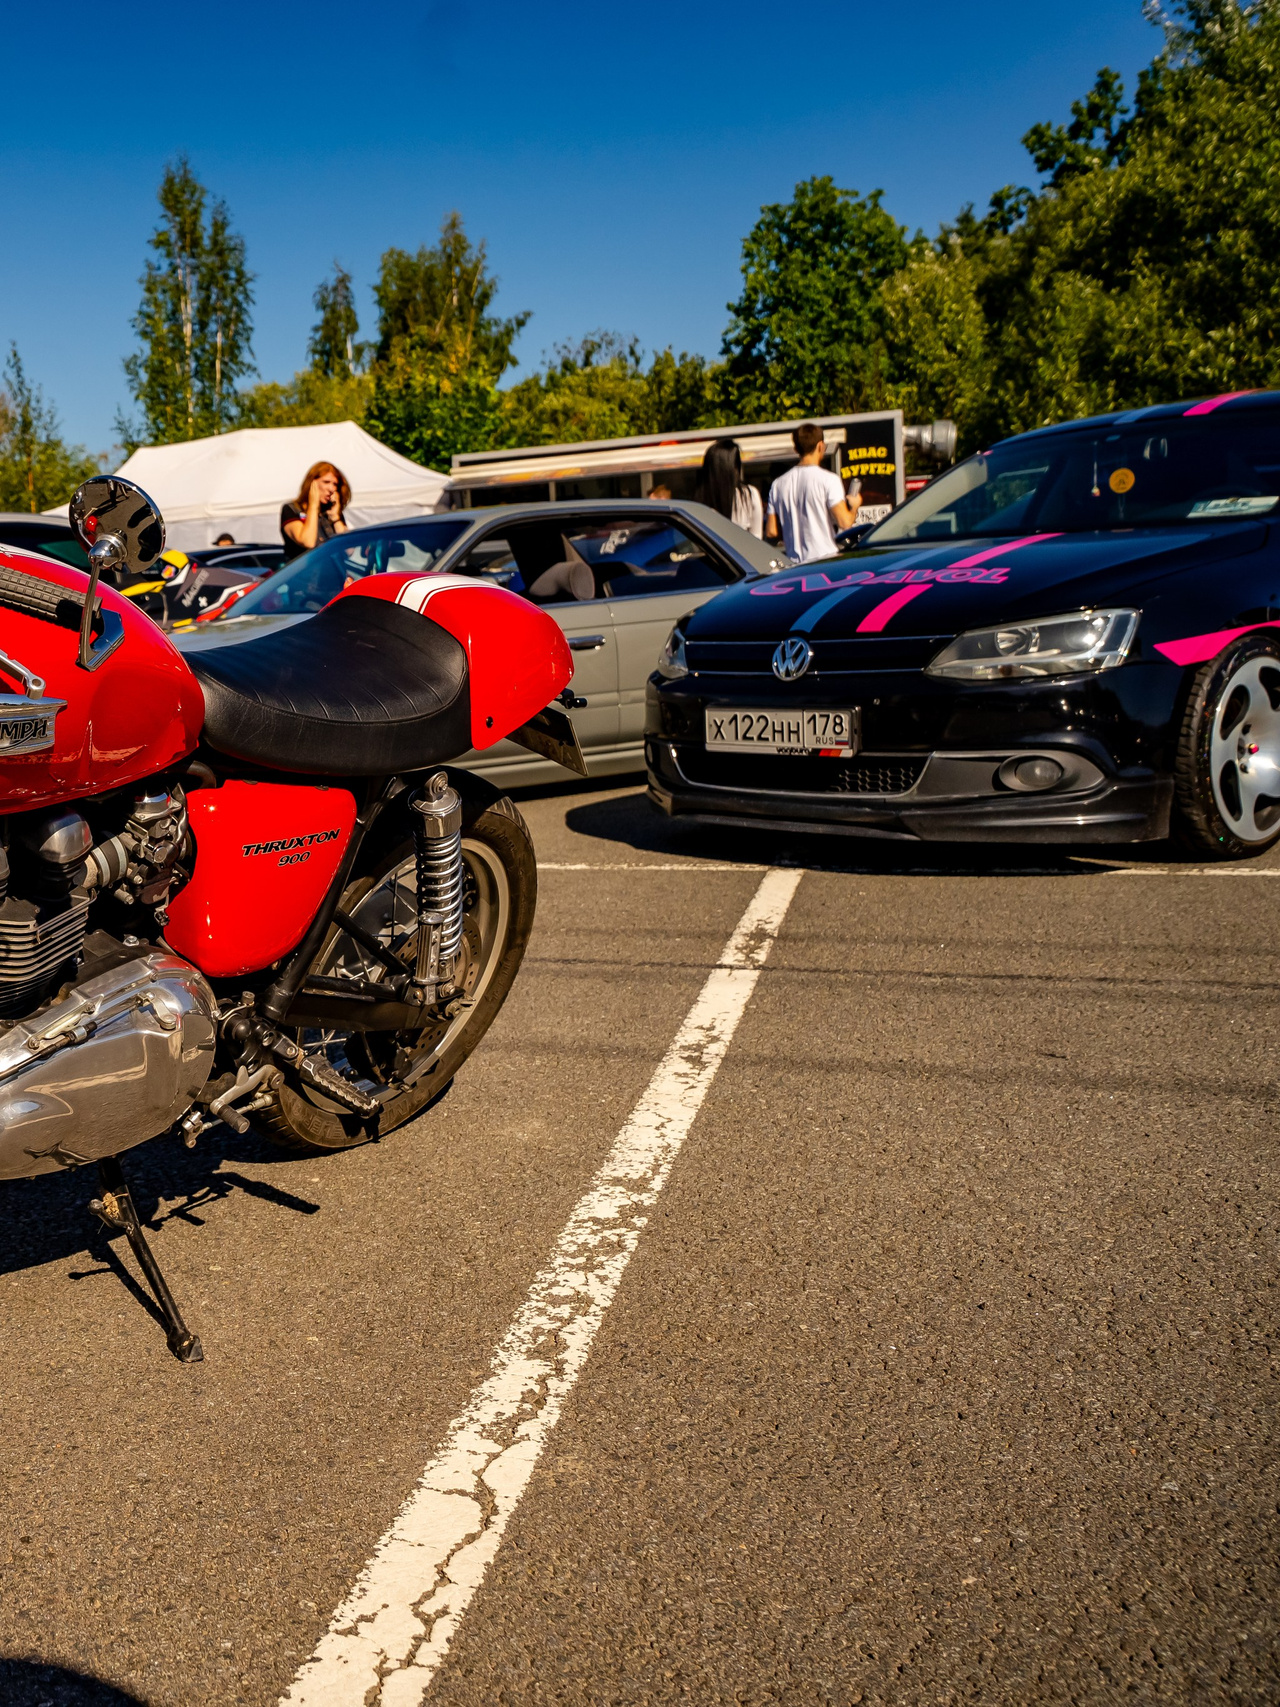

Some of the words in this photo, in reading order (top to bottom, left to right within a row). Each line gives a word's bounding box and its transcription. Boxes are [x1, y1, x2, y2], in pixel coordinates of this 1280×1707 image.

[848, 446, 888, 461] КВАС
[840, 462, 896, 479] БУРГЕР
[807, 714, 844, 735] 178
[815, 736, 834, 745] RUS
[242, 827, 341, 857] THRUXTON
[278, 851, 311, 867] 900
